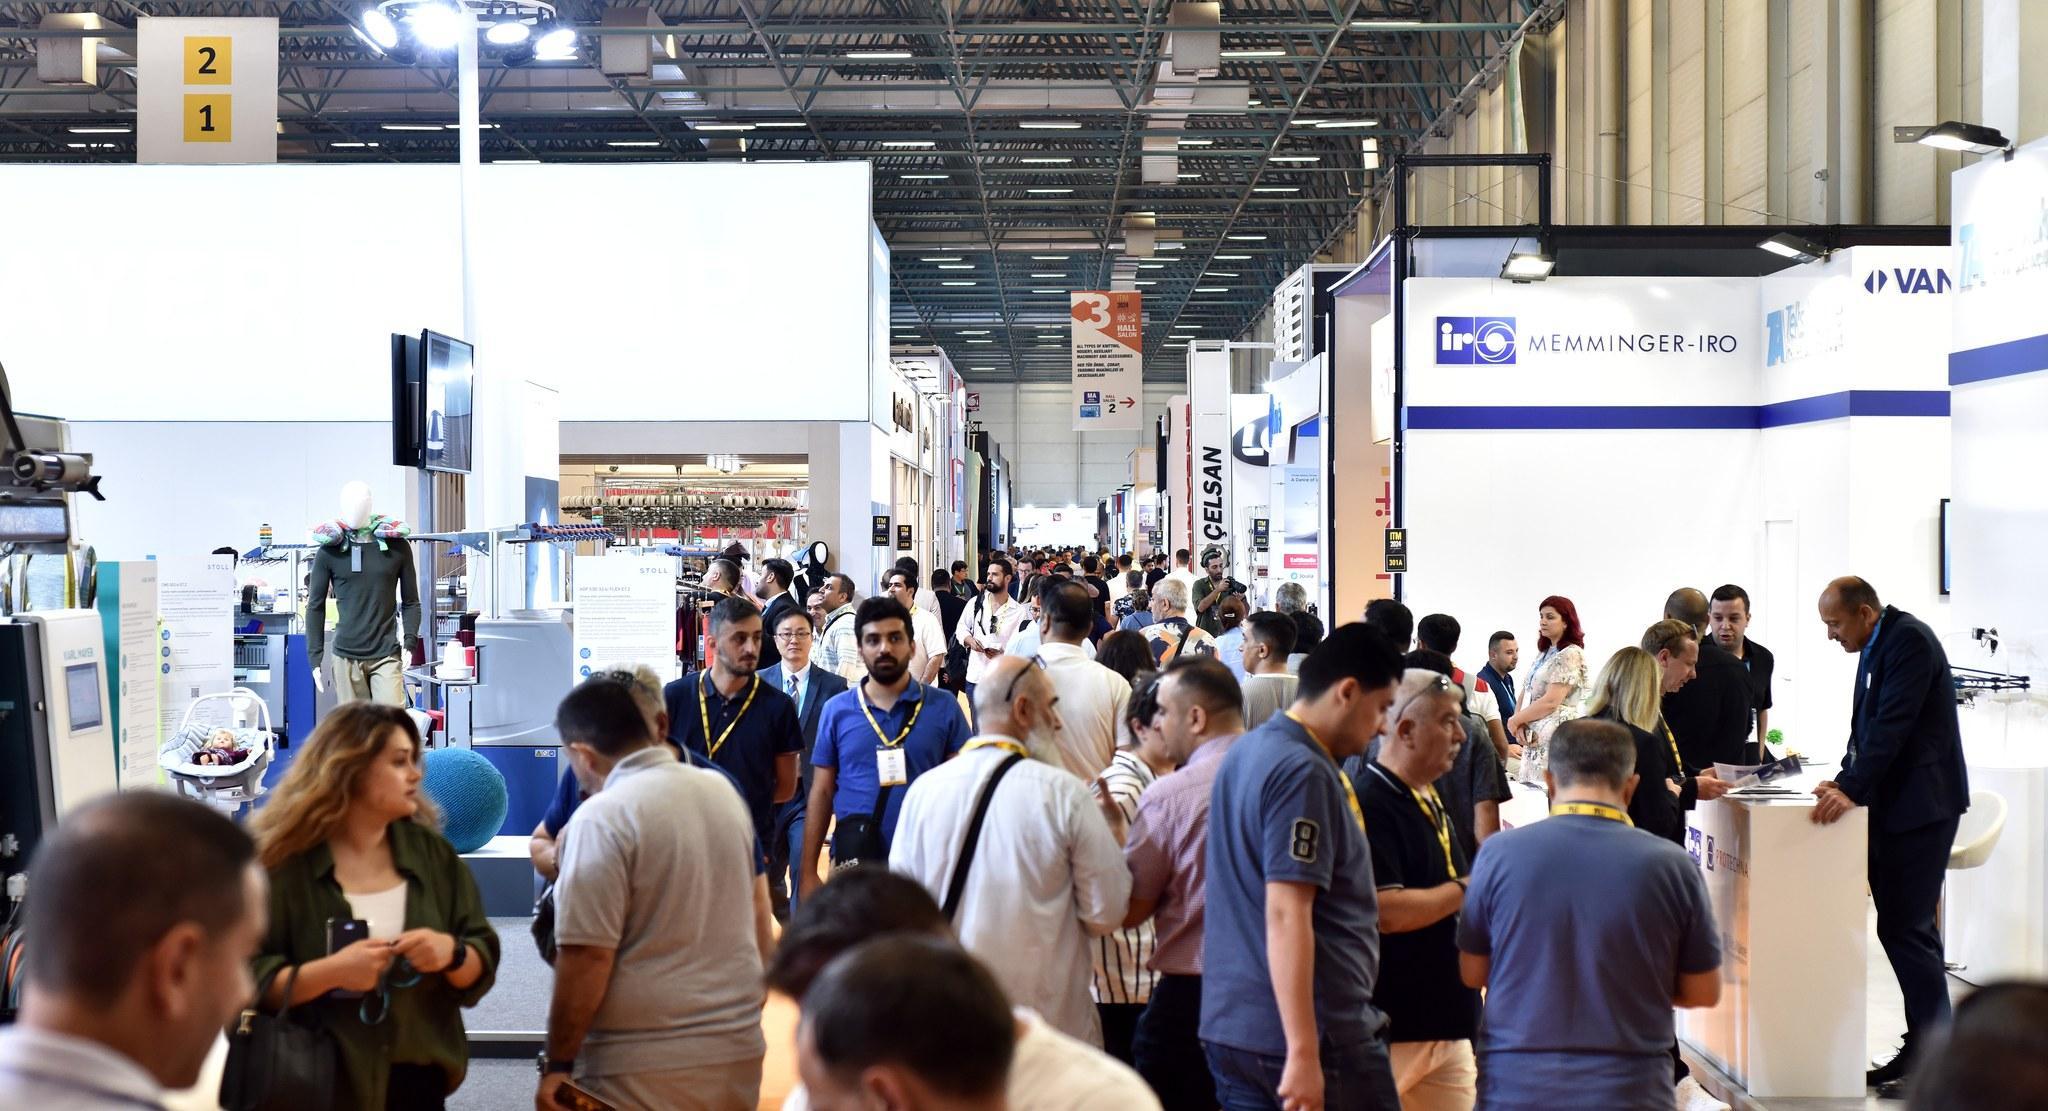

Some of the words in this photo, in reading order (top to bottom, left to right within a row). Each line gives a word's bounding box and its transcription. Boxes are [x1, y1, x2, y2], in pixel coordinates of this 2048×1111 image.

[198, 47, 216, 74] 2
[199, 104, 215, 131] 1
[1085, 293, 1111, 329] 3
[1529, 334, 1737, 353] MEMMINGER-IRO
[1109, 404, 1116, 413] 2
[1202, 446, 1227, 541] ÇELSAN
[1390, 532, 1402, 540] ITM
[1289, 817, 1320, 863] 8
